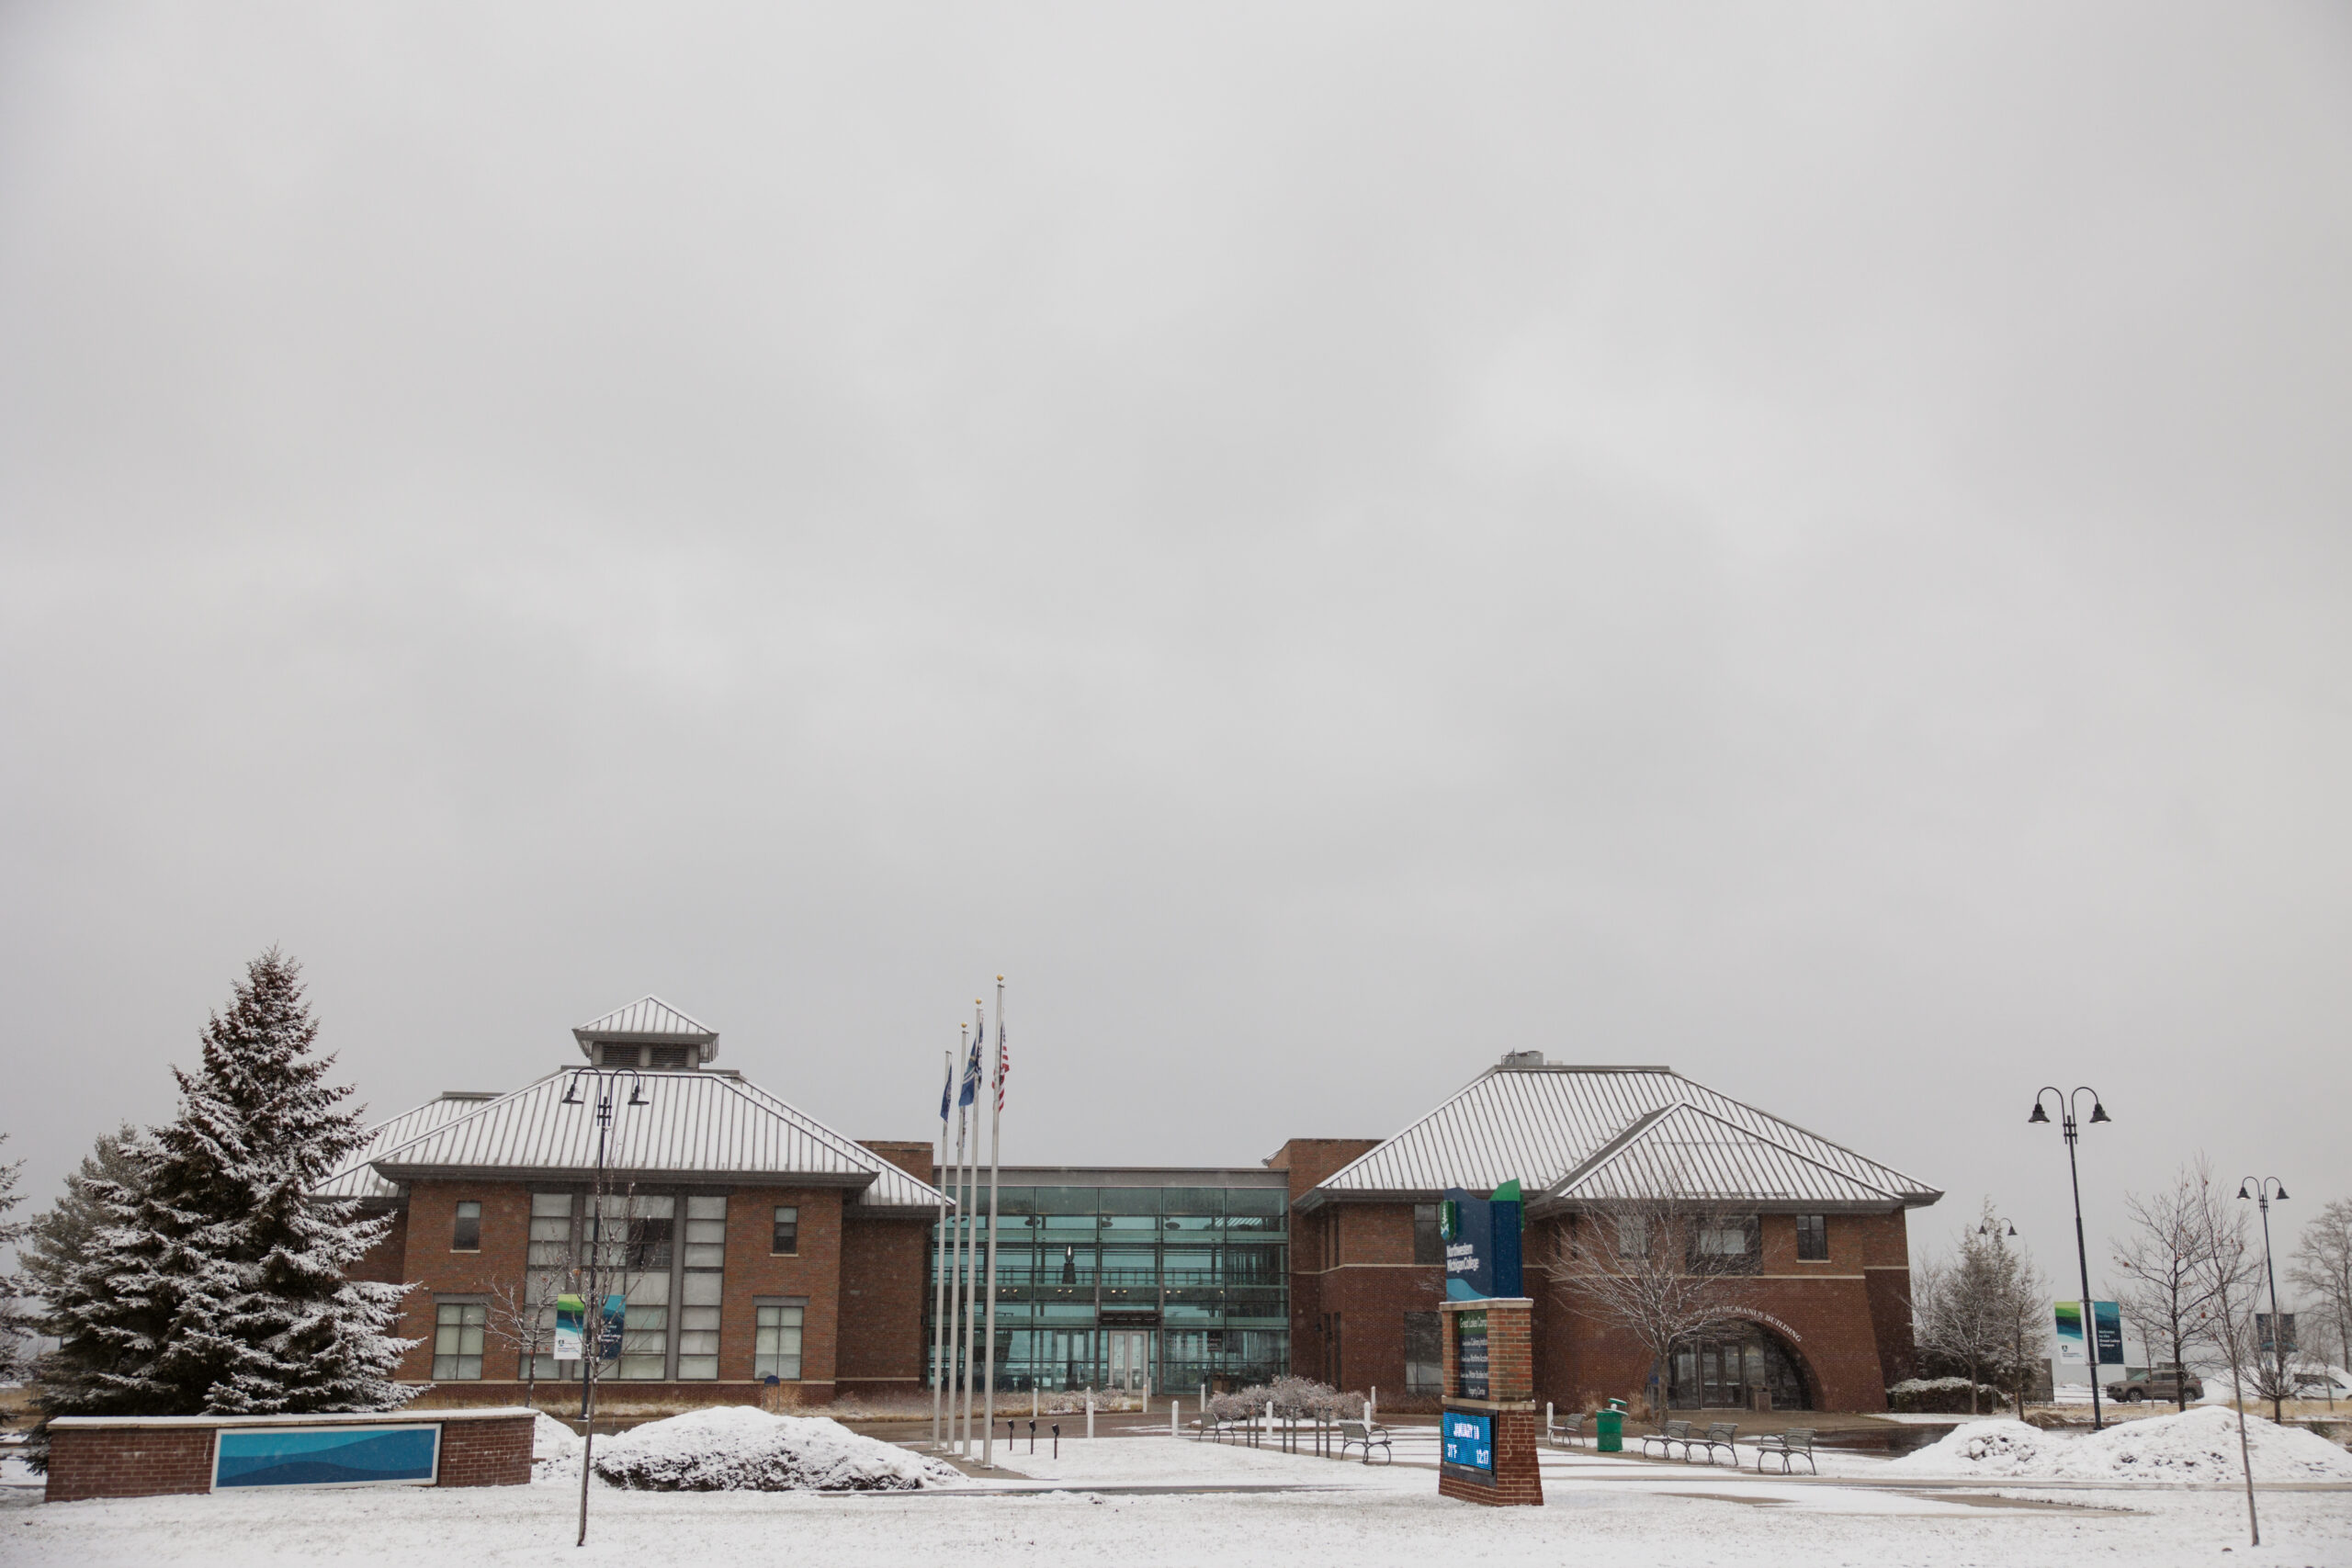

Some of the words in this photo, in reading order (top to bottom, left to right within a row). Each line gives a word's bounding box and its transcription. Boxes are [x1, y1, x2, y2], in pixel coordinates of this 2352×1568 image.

[1447, 1243, 1473, 1258] Northwestern
[1464, 1256, 1479, 1271] College
[1765, 1314, 1802, 1342] BUILDING
[1453, 1423, 1473, 1438] JANUARY
